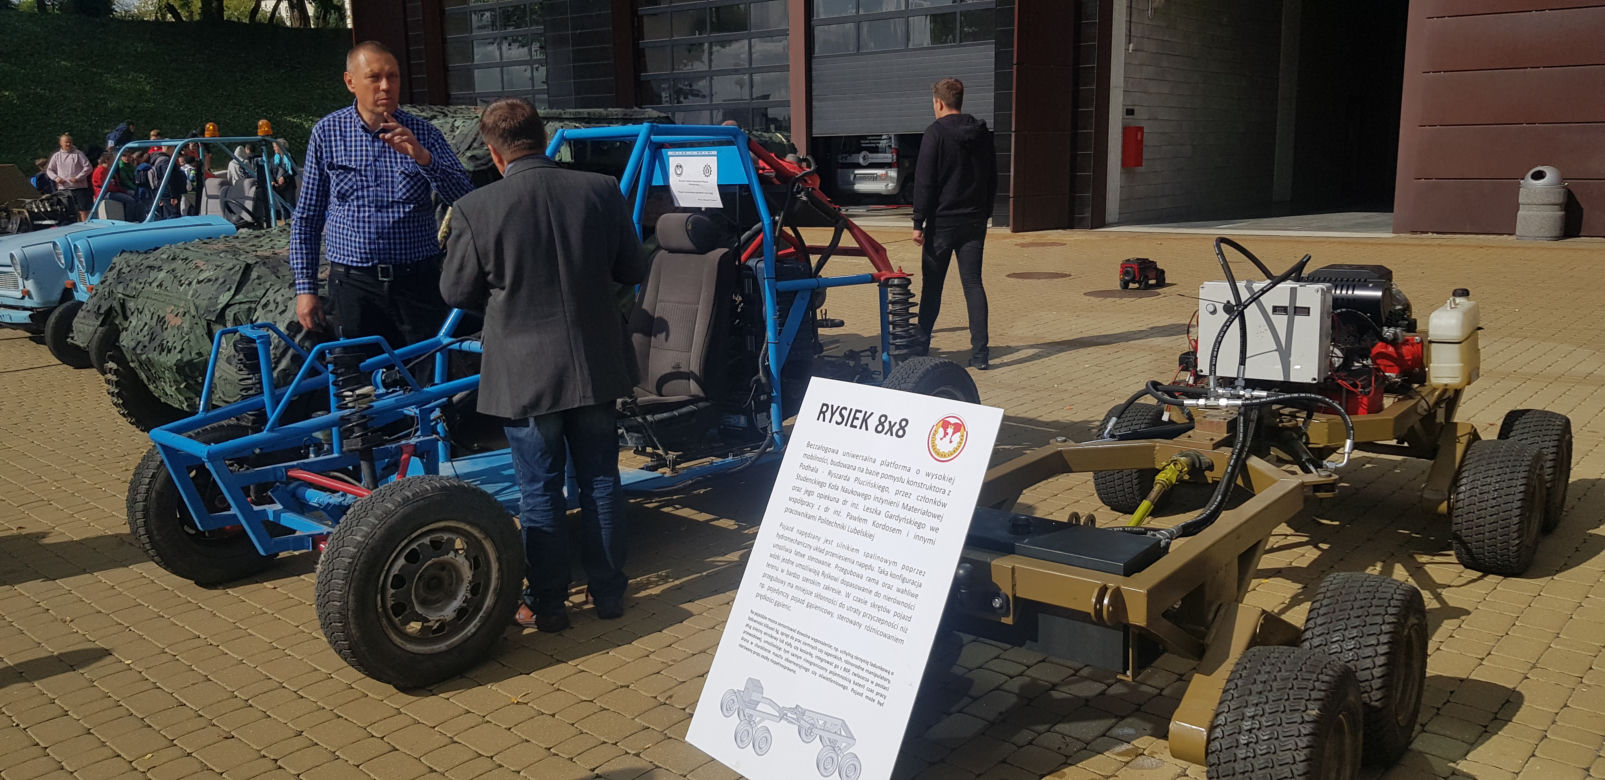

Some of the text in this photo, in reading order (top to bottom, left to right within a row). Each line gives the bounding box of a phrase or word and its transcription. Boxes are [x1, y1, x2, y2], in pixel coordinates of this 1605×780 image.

[816, 403, 909, 439] RYSIEK 8x8
[799, 462, 819, 474] Podhala
[827, 469, 851, 482] Ryszarda
[894, 489, 912, 499] przez
[916, 495, 948, 509] członków
[830, 458, 857, 471] budowana
[865, 467, 880, 478] bazie
[879, 473, 906, 484] pomysłu
[906, 477, 946, 495] konstruktora
[842, 450, 877, 464] uniwersalna
[880, 459, 911, 473] platforma
[925, 472, 955, 486] wysokiej
[792, 485, 803, 493] oraz
[803, 488, 815, 497] jego
[816, 492, 840, 504] opiekuna
[863, 504, 882, 516] Leszka
[884, 510, 927, 530] Gardyńskiego
[840, 485, 872, 501] Naukowego
[901, 502, 944, 523] Materiałowej
[845, 512, 868, 525] Pawłem
[872, 520, 902, 535] Kordosem
[913, 532, 936, 546] innymi
[847, 525, 875, 542] Lubelskiej
[822, 537, 834, 546] jest
[863, 551, 898, 567] spalinowym
[901, 564, 926, 577] poprzez
[865, 576, 880, 586] rama
[881, 581, 894, 591] oraz
[877, 566, 889, 576] Taka
[889, 570, 922, 589] konfiguracja
[893, 611, 913, 622] pojazd
